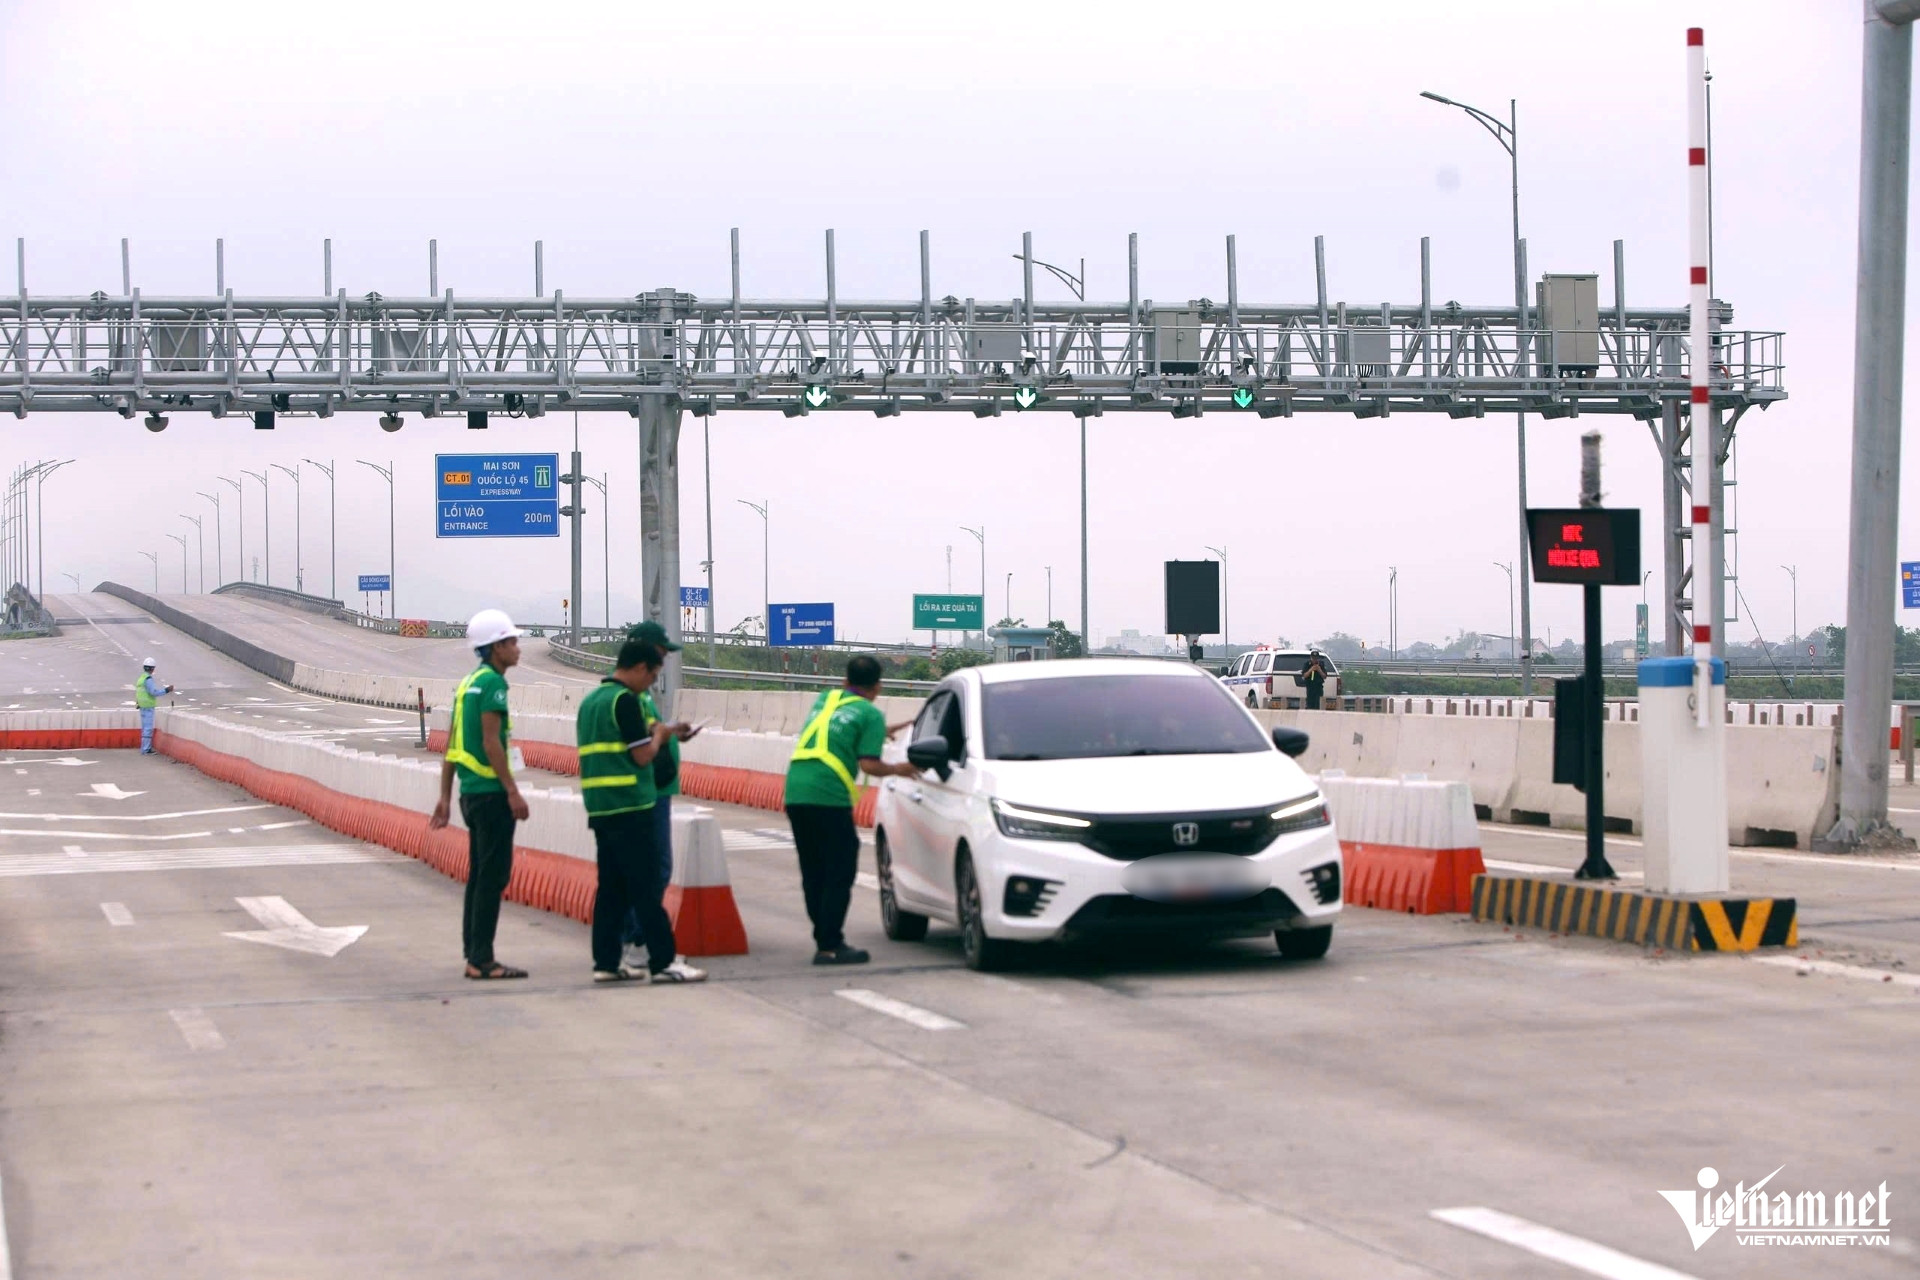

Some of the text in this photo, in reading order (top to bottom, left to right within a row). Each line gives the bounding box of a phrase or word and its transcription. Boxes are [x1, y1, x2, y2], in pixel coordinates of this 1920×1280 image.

[483, 461, 520, 470] MAI SƠN
[446, 474, 470, 483] CT.01
[477, 472, 528, 486] QUỐC LỘ 45
[444, 503, 484, 518] LỐI VÀO
[524, 514, 552, 522] 200m
[444, 522, 488, 530] ENTRANCE
